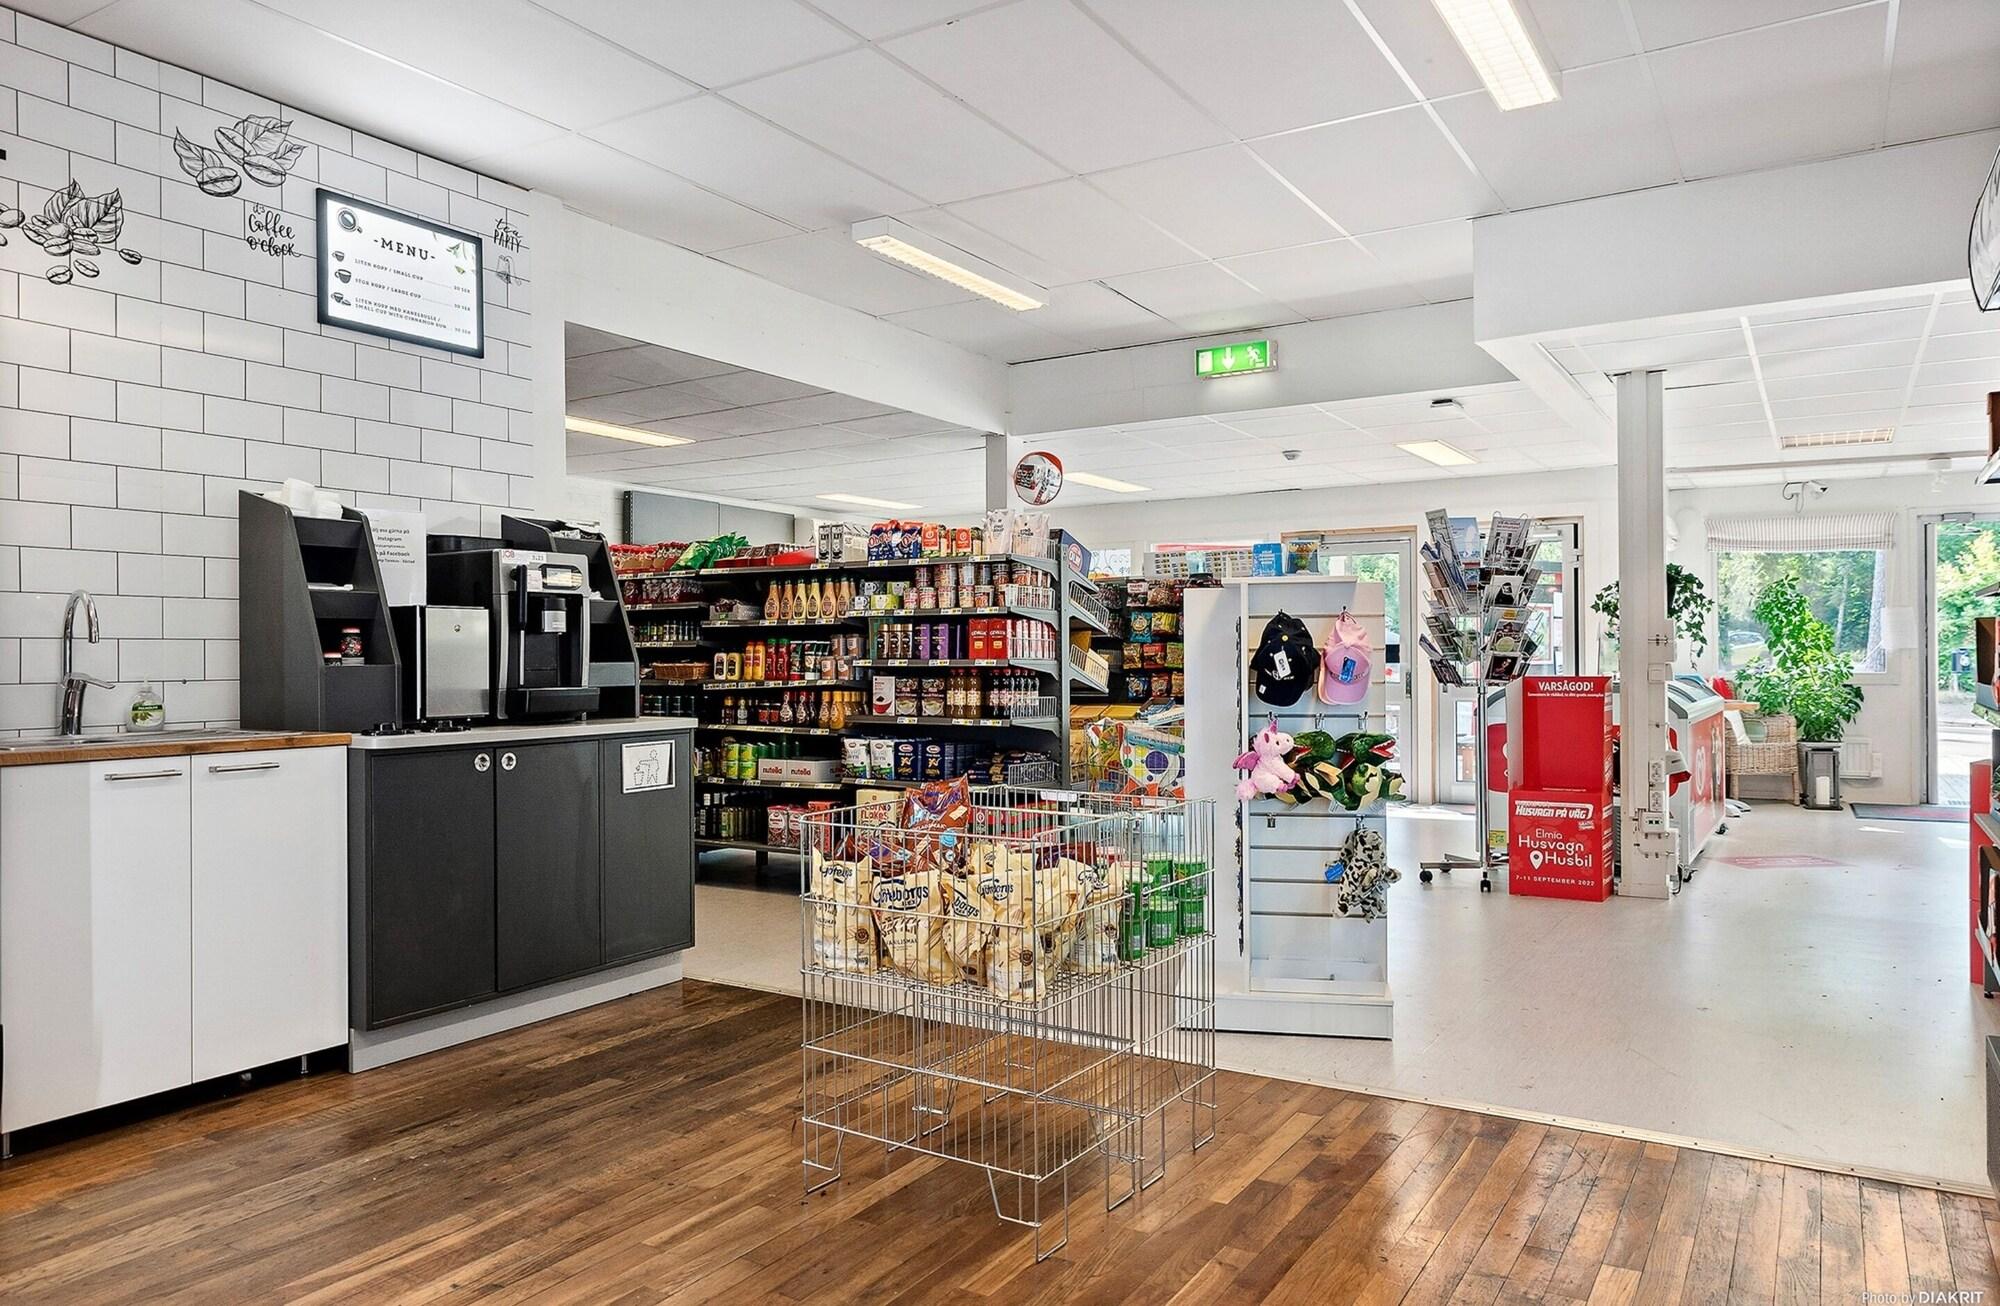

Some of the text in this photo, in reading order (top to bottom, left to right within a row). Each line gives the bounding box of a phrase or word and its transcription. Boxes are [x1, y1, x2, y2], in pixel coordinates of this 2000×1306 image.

[249, 211, 295, 239] Coffee
[494, 229, 521, 253] PARTY
[355, 258, 372, 267] LITEN
[373, 263, 388, 272] KOPP
[393, 269, 411, 278] SMALL
[355, 297, 372, 306] LITEN
[355, 303, 374, 313] SMALL
[388, 311, 404, 319] WITH
[1538, 680, 1594, 692] VARSÅGOD!
[762, 766, 783, 775] nutella
[791, 768, 811, 776] nutella
[1554, 807, 1568, 818] PÅ
[1535, 828, 1563, 840] Elmia
[1518, 834, 1584, 856] Husvagn
[1545, 851, 1593, 868] Husbil
[1533, 876, 1576, 885] SEPTEMBER
